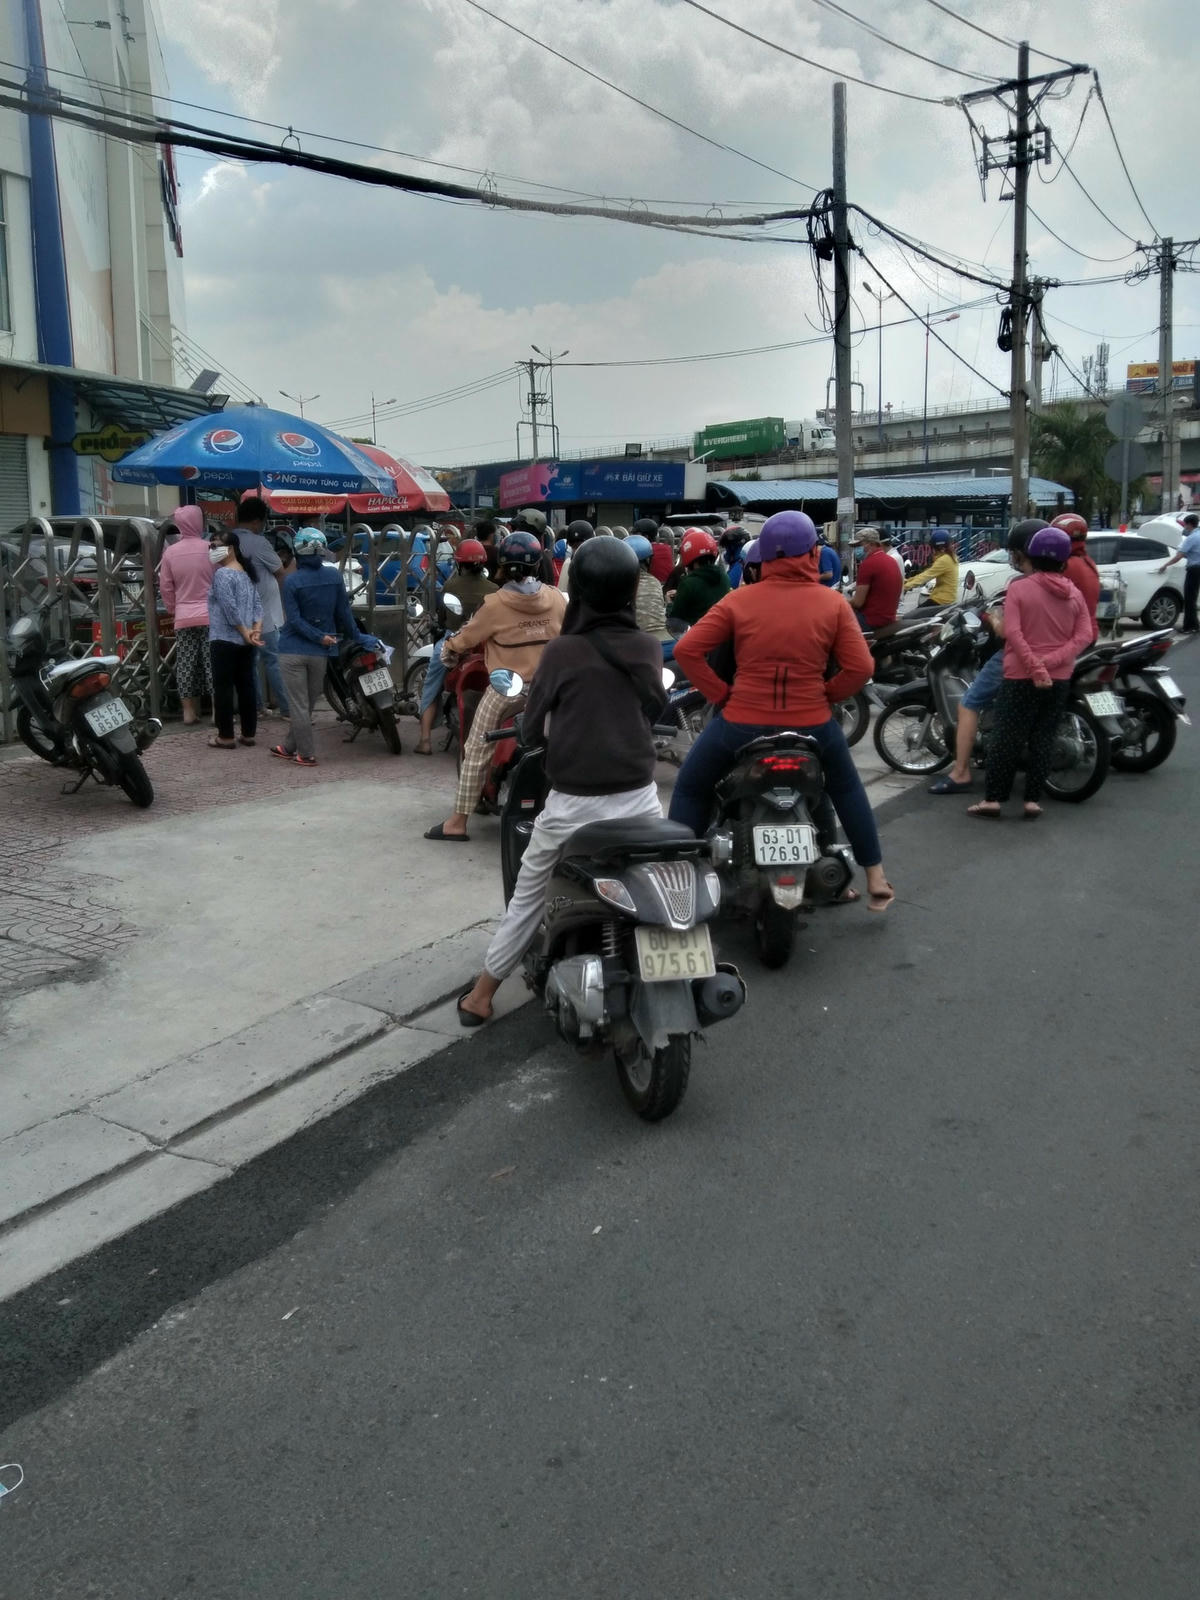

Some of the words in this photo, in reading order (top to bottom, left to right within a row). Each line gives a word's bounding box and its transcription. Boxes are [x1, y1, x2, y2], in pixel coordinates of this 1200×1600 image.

[203, 471, 233, 481] pepsi
[653, 474, 664, 482] XE
[367, 496, 408, 506] HAPACOL
[366, 679, 389, 694] 3198
[97, 712, 127, 732] 8582
[759, 845, 809, 862] 126.91
[644, 950, 709, 976] 975.61
